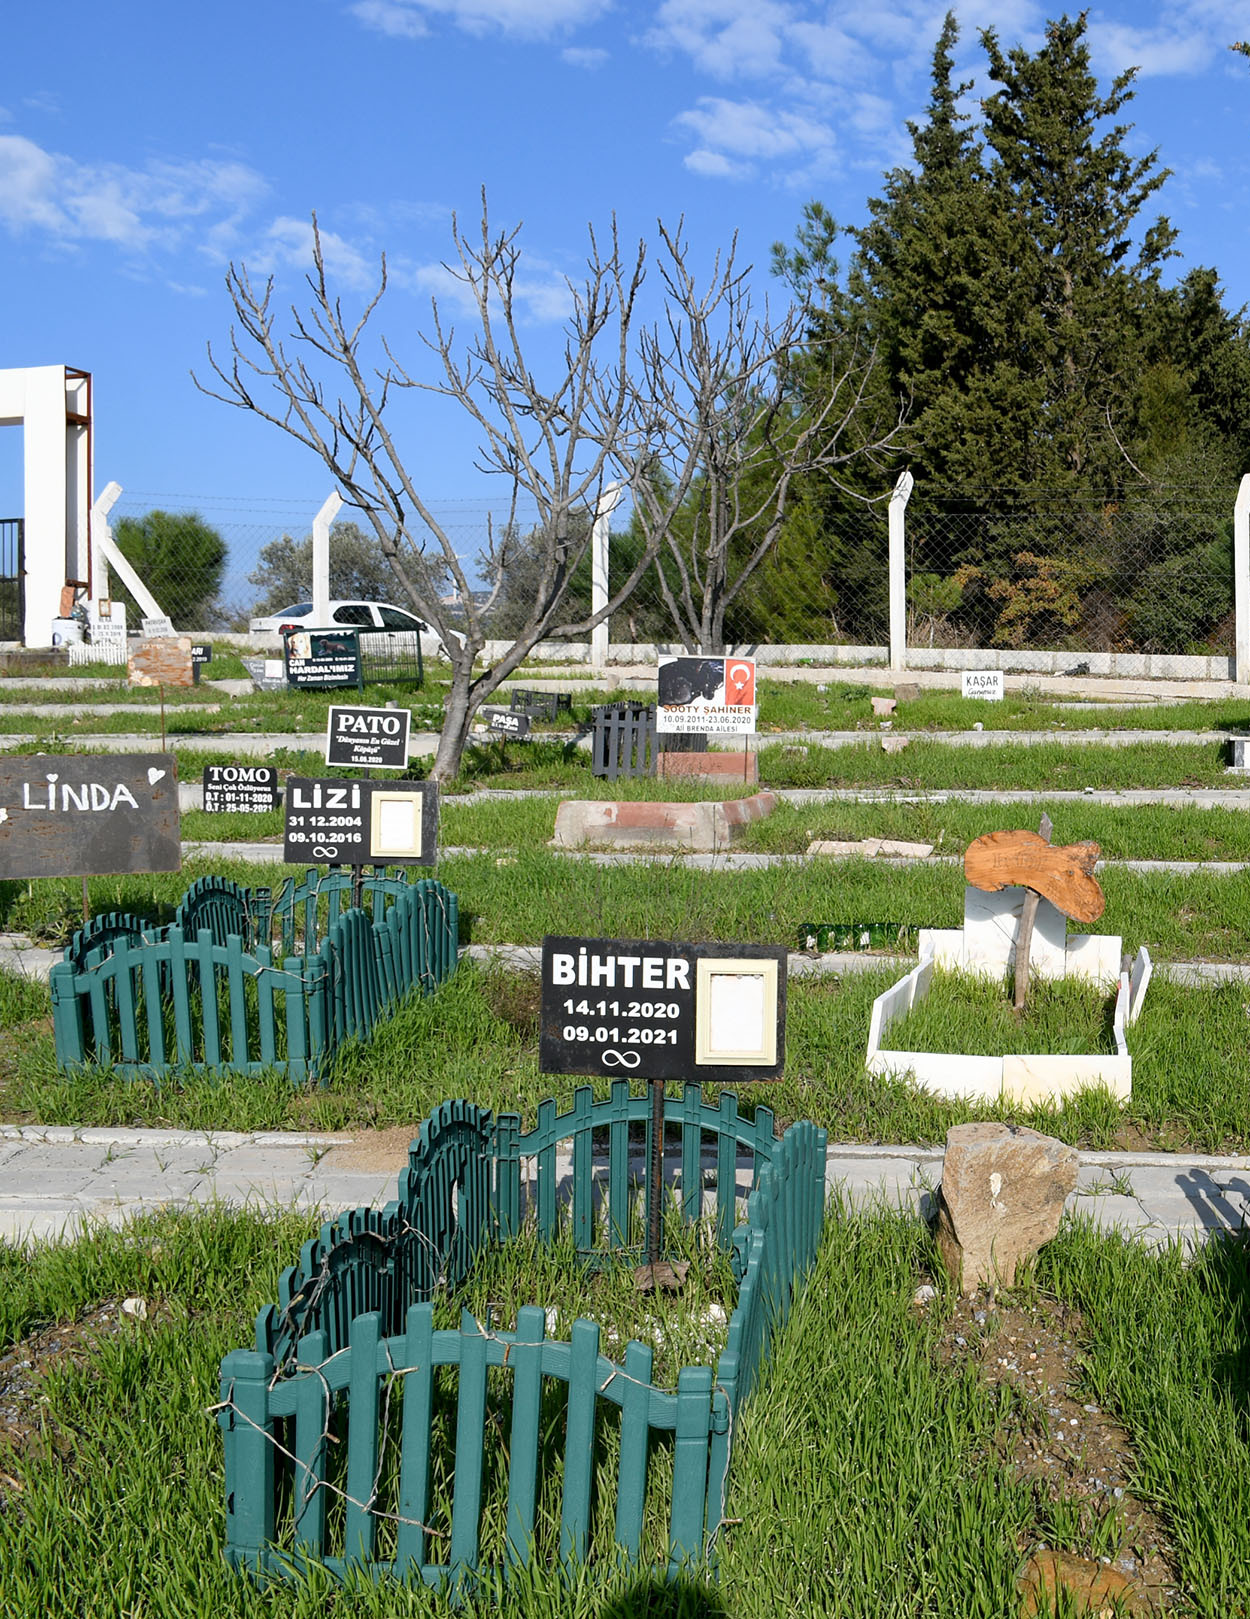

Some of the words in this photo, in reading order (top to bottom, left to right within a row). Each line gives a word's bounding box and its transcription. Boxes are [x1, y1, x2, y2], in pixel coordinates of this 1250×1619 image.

[966, 675, 999, 688] KAŞAR
[663, 704, 700, 713] SOOTY
[703, 705, 751, 715] ŞAHİNER
[337, 714, 400, 735] PATO
[370, 737, 380, 745] En
[381, 737, 401, 746] Güzel
[209, 767, 271, 783] TOMO
[223, 783, 237, 792] Çok
[237, 783, 272, 792] Özlüyoruz
[205, 792, 219, 801] D.T
[225, 792, 273, 803] 01-11-2020
[292, 783, 361, 809] LİZİ
[205, 801, 219, 812] Ö.T
[288, 816, 305, 827] 31
[309, 816, 362, 827] 12.2004
[288, 832, 362, 843] 09.10.2016
[552, 947, 691, 990] BİHTER
[563, 999, 681, 1019] 14.11.2020
[562, 1025, 678, 1045] 09.01.2021
